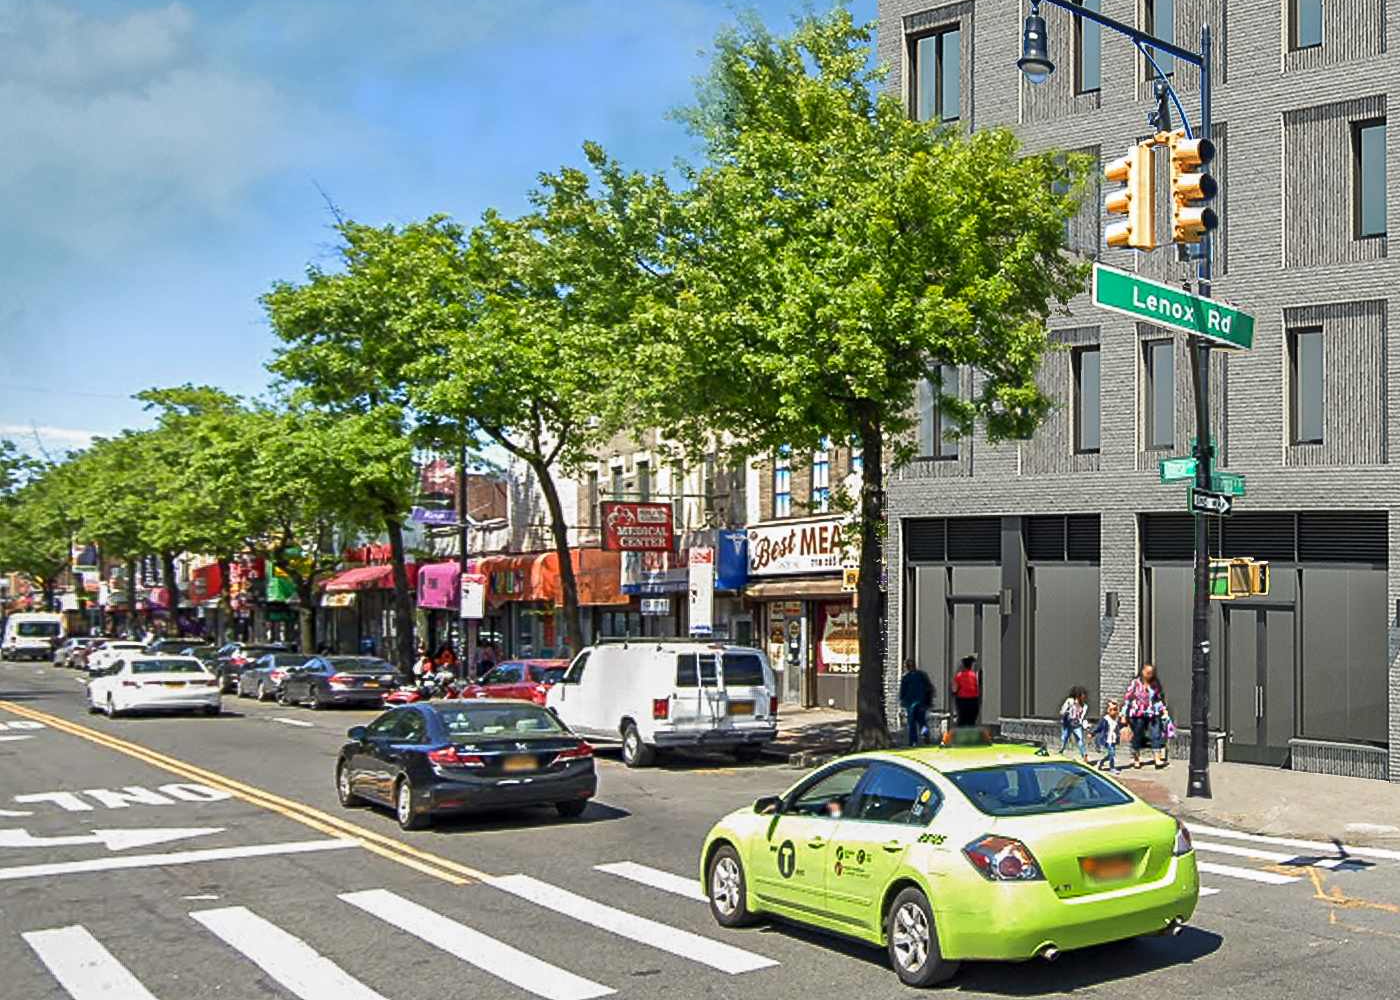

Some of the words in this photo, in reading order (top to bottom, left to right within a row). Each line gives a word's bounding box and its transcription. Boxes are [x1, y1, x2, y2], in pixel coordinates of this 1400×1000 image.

[1133, 286, 1195, 323] Lenox
[1208, 309, 1232, 334] Rd
[616, 526, 668, 536] MEDICAL
[620, 536, 667, 547] CENTER
[750, 529, 796, 570] Best
[800, 524, 845, 556] MEA
